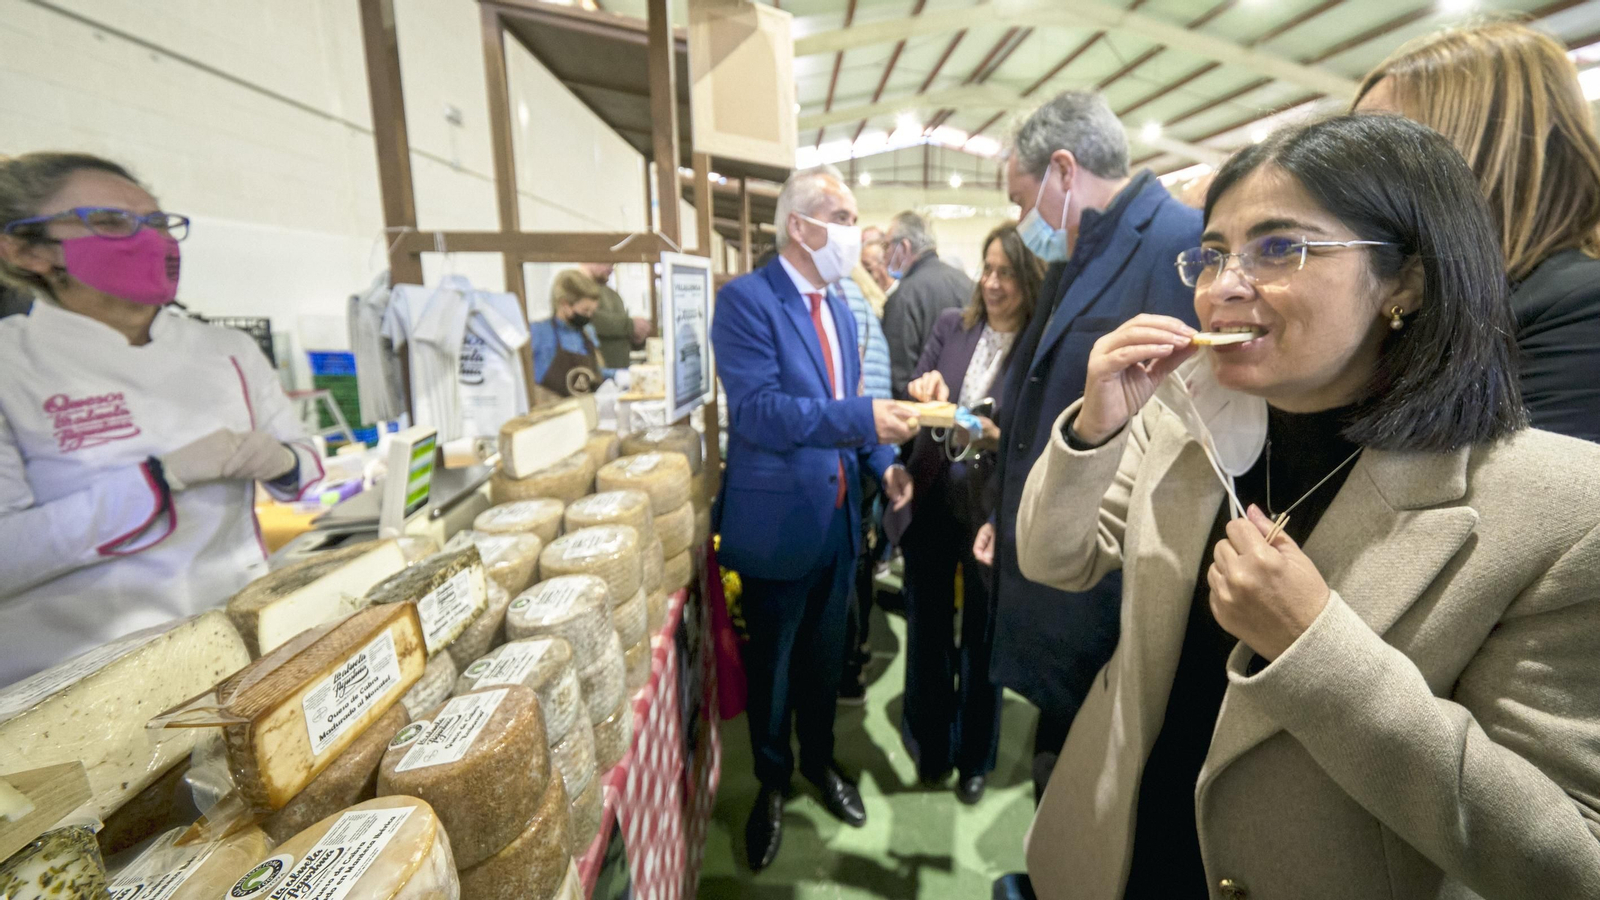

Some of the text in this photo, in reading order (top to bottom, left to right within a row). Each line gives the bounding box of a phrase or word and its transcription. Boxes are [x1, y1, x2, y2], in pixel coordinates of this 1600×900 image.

[333, 665, 369, 698] Agustina
[341, 653, 367, 677] abuela
[319, 707, 356, 742] Madurado
[357, 698, 365, 708] al
[365, 674, 391, 701] Moscatel
[328, 702, 349, 723] Queso
[350, 694, 360, 703] de
[360, 676, 379, 694] Cabra
[271, 887, 287, 900] La
[286, 849, 323, 887] abuela
[334, 866, 346, 877] de
[343, 841, 367, 865] Cabra
[336, 875, 348, 886] en
[344, 840, 376, 873] Manteca
[373, 816, 396, 839] Ibérica
